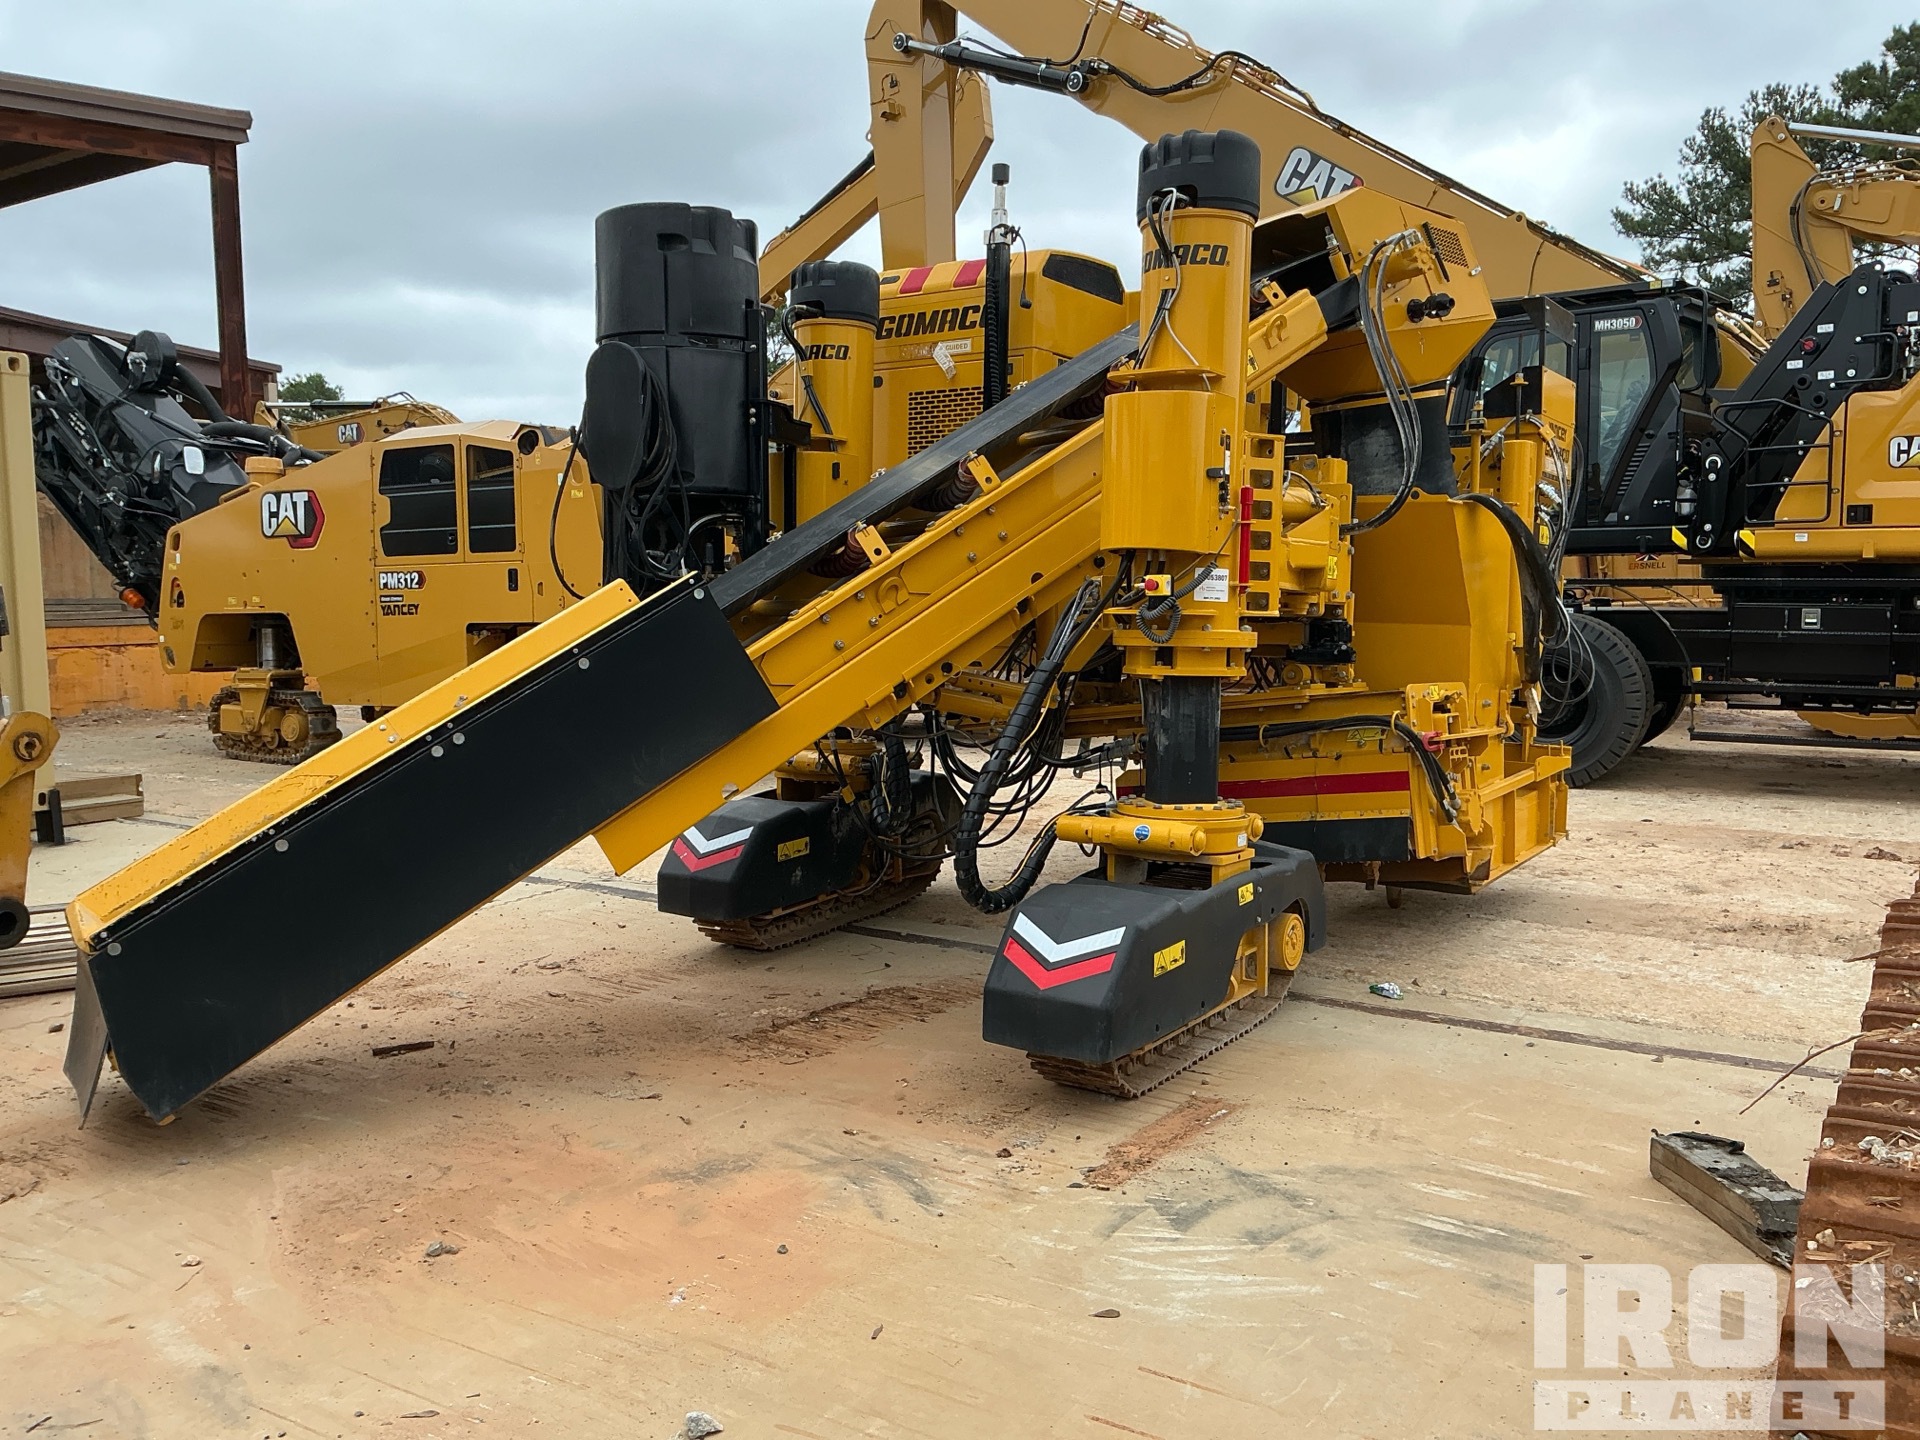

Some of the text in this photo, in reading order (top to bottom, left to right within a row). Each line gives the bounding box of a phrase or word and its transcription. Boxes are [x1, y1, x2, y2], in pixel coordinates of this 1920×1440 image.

[1276, 148, 1354, 201] CAT
[1594, 317, 1636, 331] MH3050
[945, 342, 969, 350] GUIDED
[338, 423, 358, 443] CAT
[1889, 436, 1920, 467] CA
[262, 491, 309, 537] CAT
[379, 571, 419, 589] PM312
[380, 604, 420, 616] YANCEY
